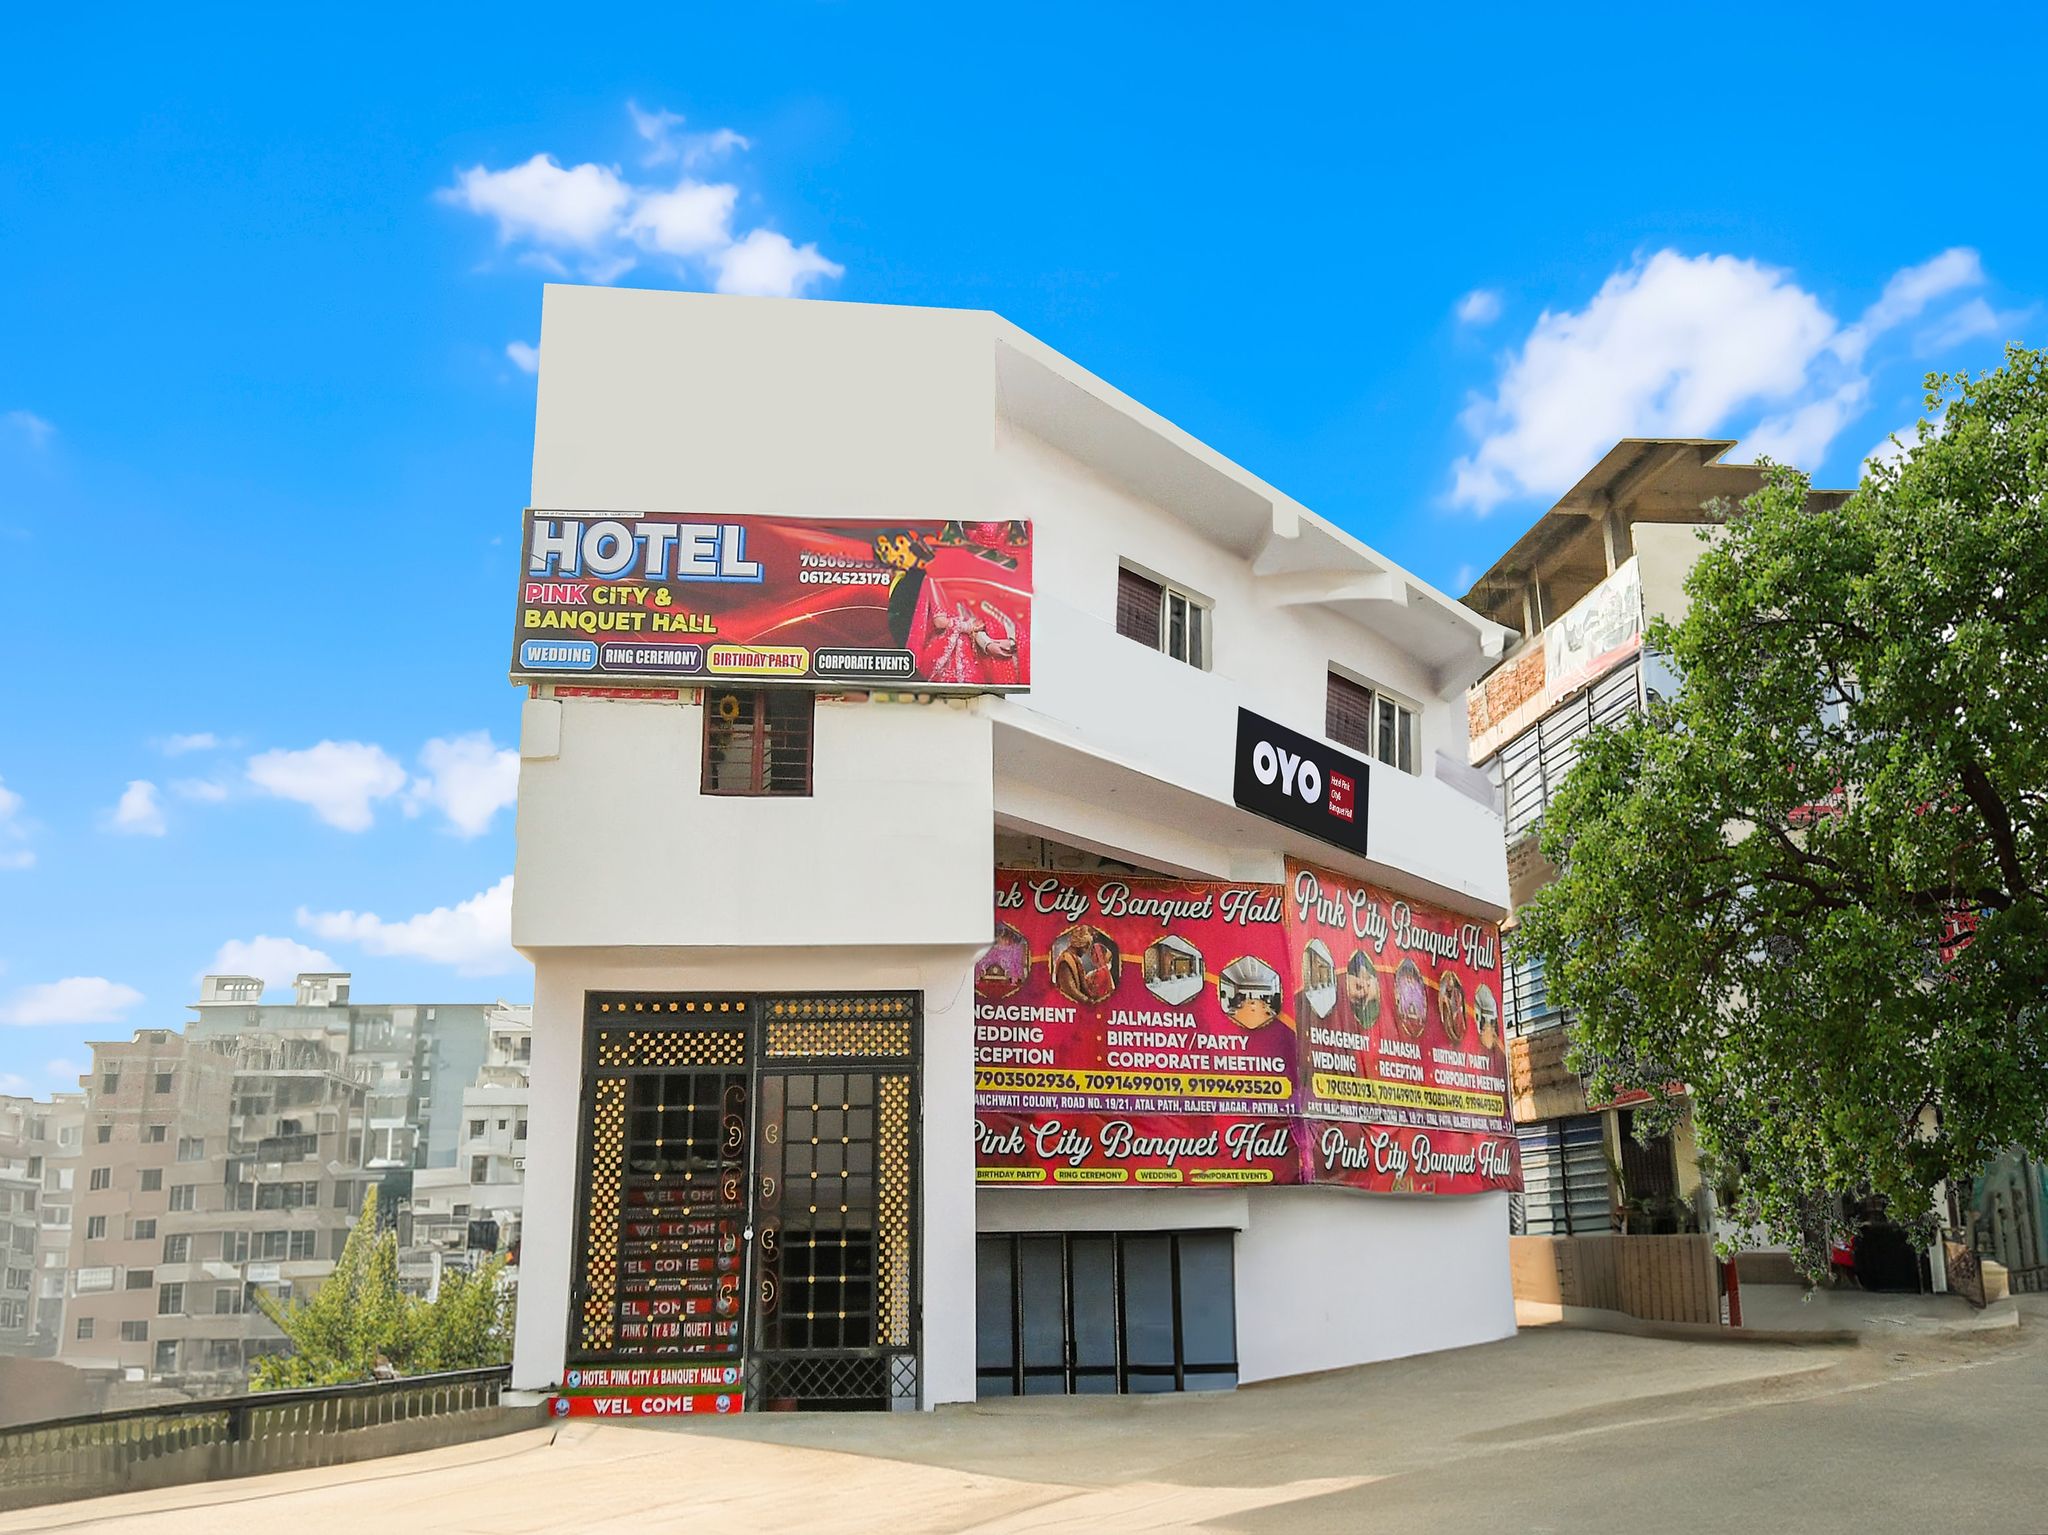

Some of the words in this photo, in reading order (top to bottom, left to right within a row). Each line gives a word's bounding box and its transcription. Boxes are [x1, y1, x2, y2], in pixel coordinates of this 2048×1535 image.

[529, 520, 764, 583] HOTEL
[800, 571, 890, 585] 06124523178
[525, 583, 589, 604] PINK
[655, 588, 672, 606] &
[524, 610, 646, 633] BANQUET
[651, 613, 717, 633] HALL
[528, 647, 591, 662] WEDDING
[606, 650, 633, 664] RING
[636, 650, 697, 665] CEREMONY
[714, 653, 766, 667] BIRTHDAY
[769, 654, 803, 668] PARTY
[818, 654, 873, 670] CORPORATE
[875, 655, 910, 670] EVENTS
[1253, 740, 1321, 804] OYO
[1028, 878, 1090, 922] City
[1097, 881, 1213, 926] Banquet
[1219, 889, 1282, 925] Hall
[1295, 870, 1346, 928] Pink
[1347, 888, 1388, 954] City
[1391, 901, 1459, 968] Banquet
[1462, 923, 1495, 971] Hall
[1107, 1010, 1196, 1028] JALMASHA
[974, 1026, 1043, 1043] EDDING
[1310, 1027, 1370, 1051] ENGAGEMENT
[1378, 1038, 1422, 1060] JALMASHA
[1107, 1052, 1210, 1070] CORPORATE
[1214, 1055, 1285, 1072] MEETING
[1311, 1050, 1356, 1073] WEDDING
[1379, 1060, 1424, 1082] RECEPTION
[975, 1071, 1080, 1091] 7903502936,
[1085, 1075, 1183, 1095] 7091499019,
[1188, 1078, 1282, 1095] 9199493520
[1434, 1068, 1476, 1089] CORPORATE
[1476, 1075, 1505, 1092] MEETING
[1023, 1095, 1059, 1110] COLONY,
[1061, 1097, 1085, 1108] ROAD
[1088, 1098, 1102, 1109] NO.
[1135, 1099, 1155, 1110] ATAL
[1157, 1099, 1182, 1112] PATH,
[1184, 1100, 1216, 1112] RAJEEV
[1253, 1102, 1278, 1113] PATNA
[1029, 1120, 1093, 1166] City
[1100, 1120, 1219, 1166] Banquet
[1225, 1122, 1288, 1161] Hall
[1321, 1127, 1369, 1170] Pink
[1370, 1132, 1409, 1181] City
[1411, 1134, 1476, 1180] Banquet
[1478, 1141, 1510, 1179] Hall
[1059, 1171, 1078, 1179] RING
[1080, 1171, 1122, 1179] CEREMONY
[622, 1324, 641, 1338] PINK
[582, 1370, 608, 1386] HOTEL
[610, 1369, 630, 1385] PINK
[632, 1369, 650, 1385] CITY
[653, 1371, 659, 1385] &
[661, 1369, 698, 1384] BANQUET
[700, 1368, 721, 1383] HALL
[593, 1398, 632, 1414] WEL
[642, 1396, 693, 1413] COME
